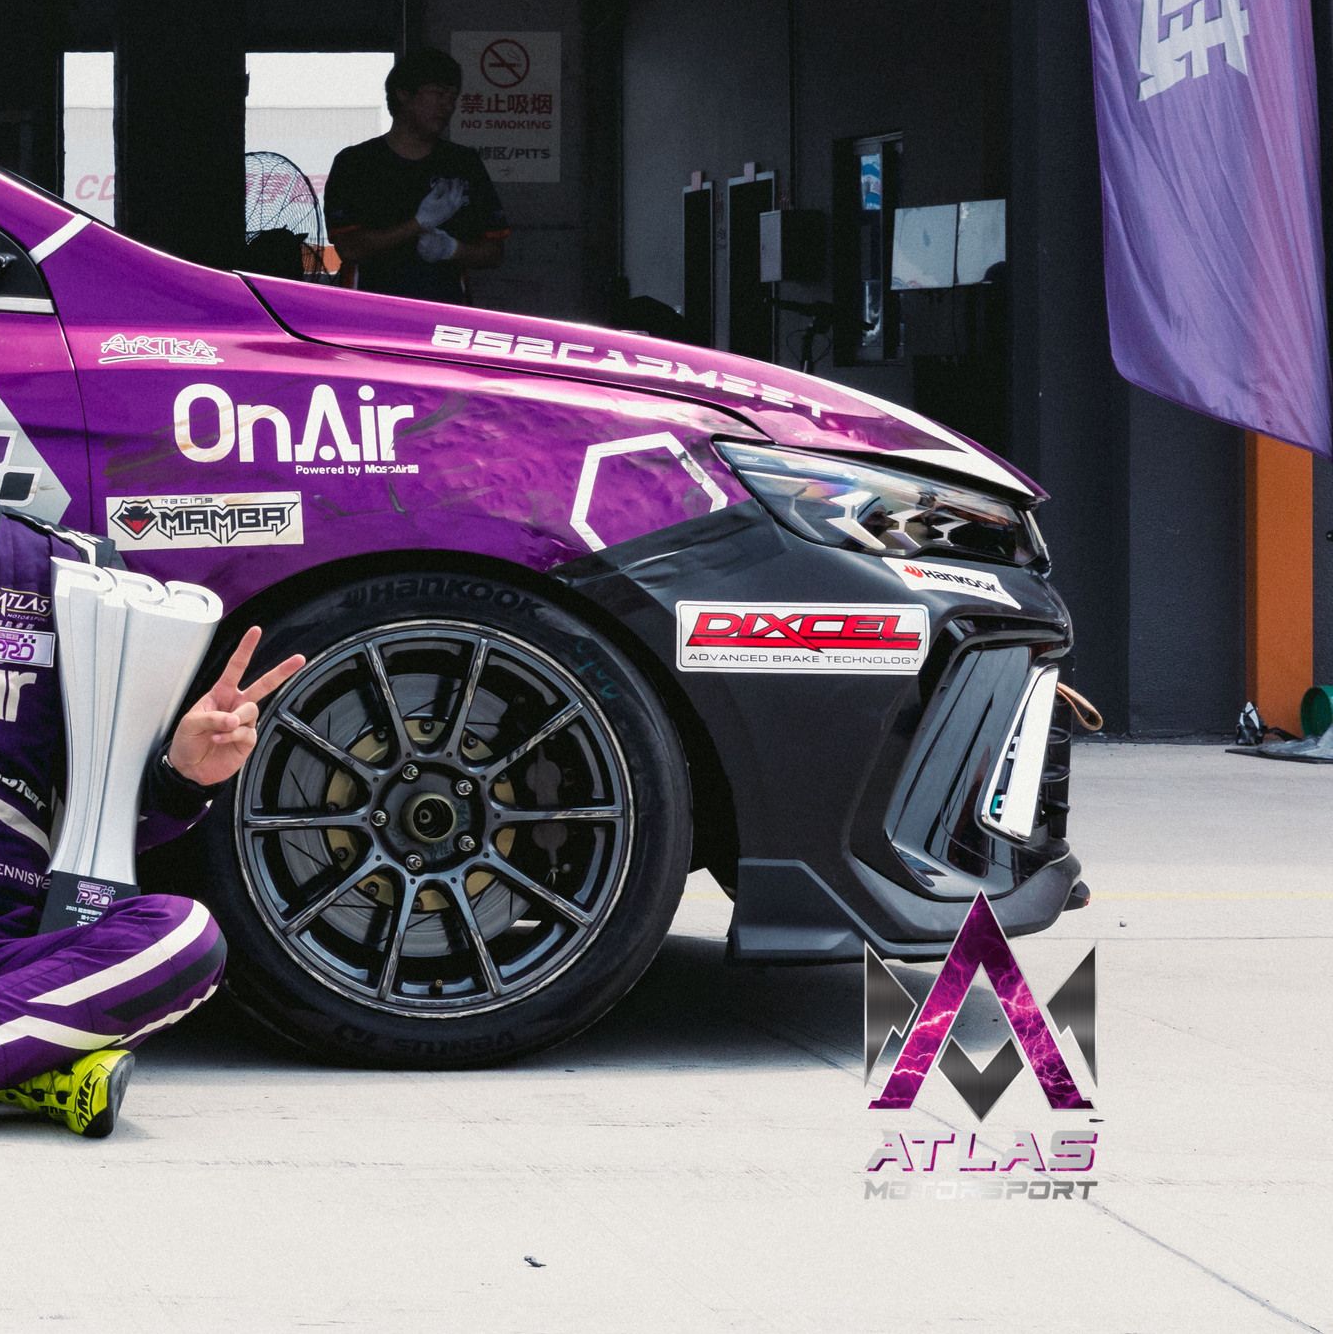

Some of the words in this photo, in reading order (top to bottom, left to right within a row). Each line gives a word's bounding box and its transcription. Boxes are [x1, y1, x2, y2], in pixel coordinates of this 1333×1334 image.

[461, 93, 552, 114] 禁止吸烟
[461, 120, 482, 129] NO
[485, 120, 551, 129] SMOKING
[173, 383, 414, 463] OnAir
[295, 465, 345, 475] Powered
[347, 465, 361, 476] by
[159, 505, 290, 532] MAMBA
[686, 612, 923, 653] DIXCEL
[688, 653, 768, 663] ADVANCED
[772, 654, 820, 664] BRAKE
[825, 655, 920, 665] TECHNOLOGY
